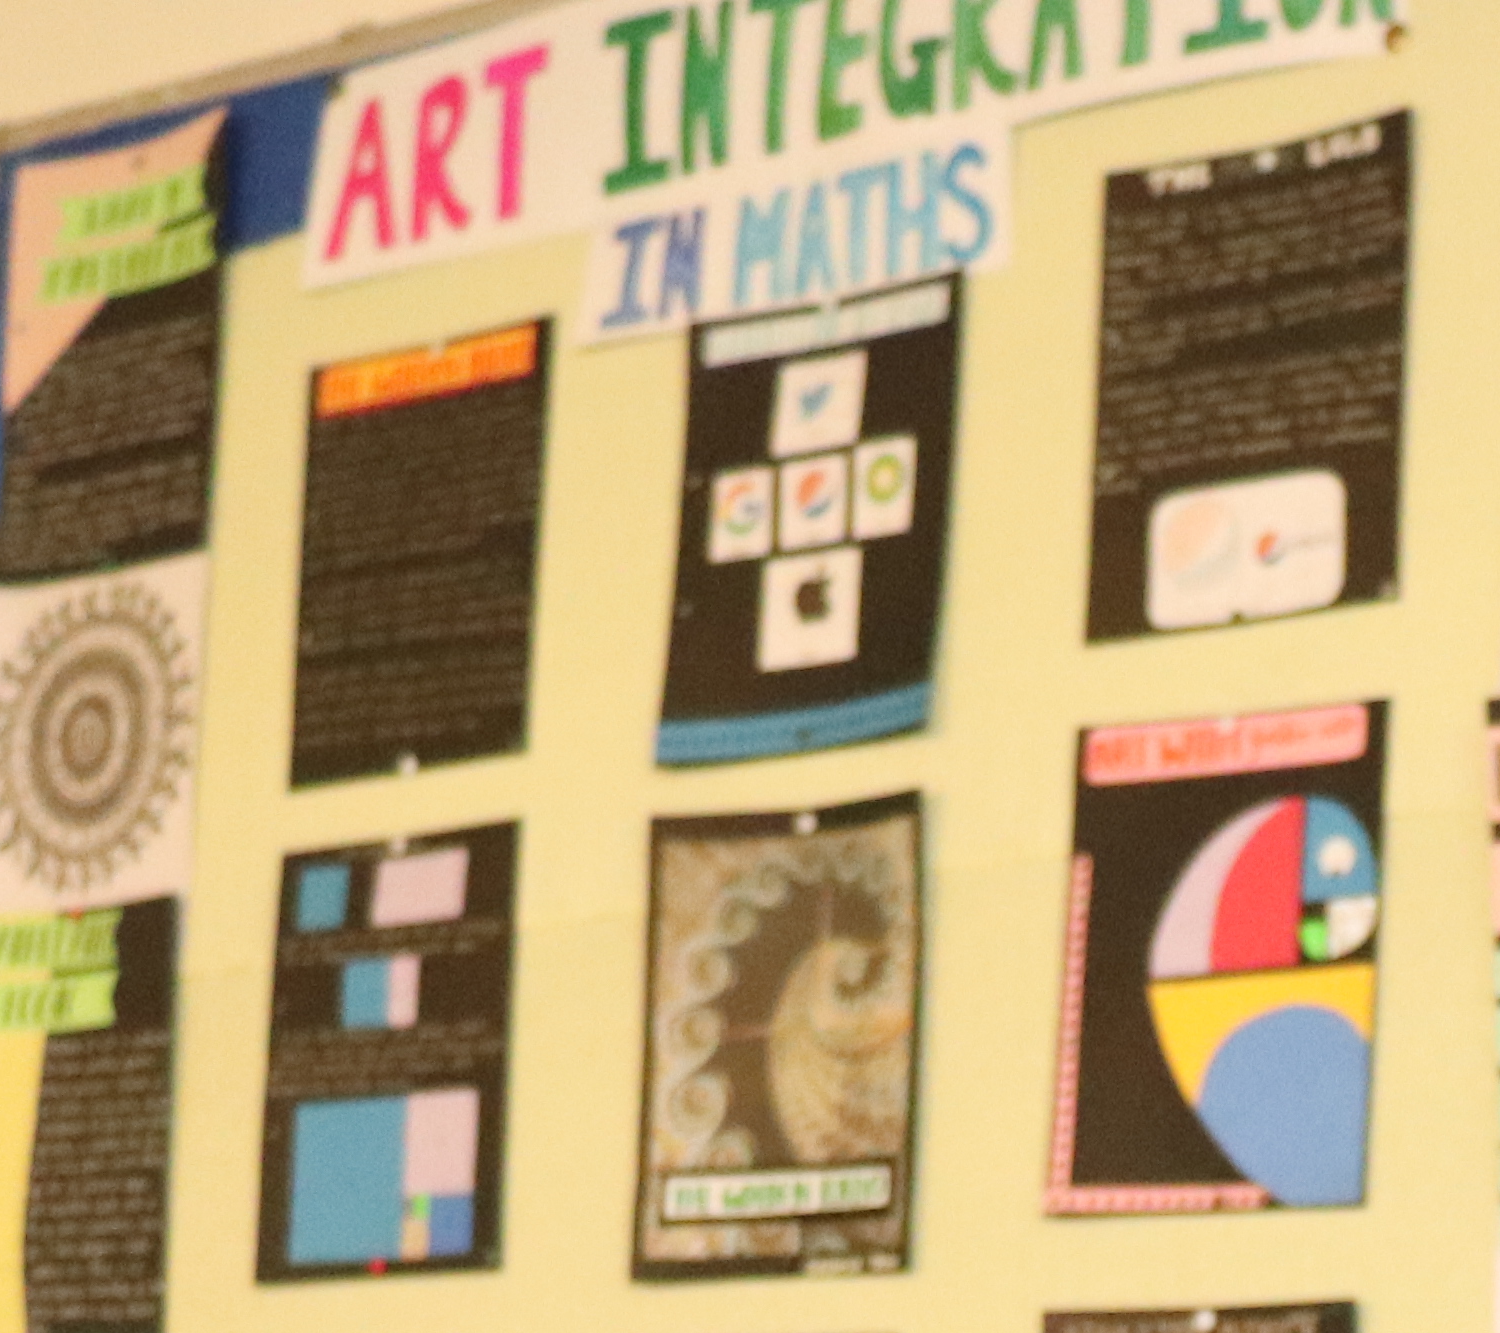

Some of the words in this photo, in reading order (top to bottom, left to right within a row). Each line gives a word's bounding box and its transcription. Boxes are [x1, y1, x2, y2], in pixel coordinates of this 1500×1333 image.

[323, 43, 550, 261] ART
[601, 208, 707, 330] IN
[730, 142, 991, 308] MATHS
